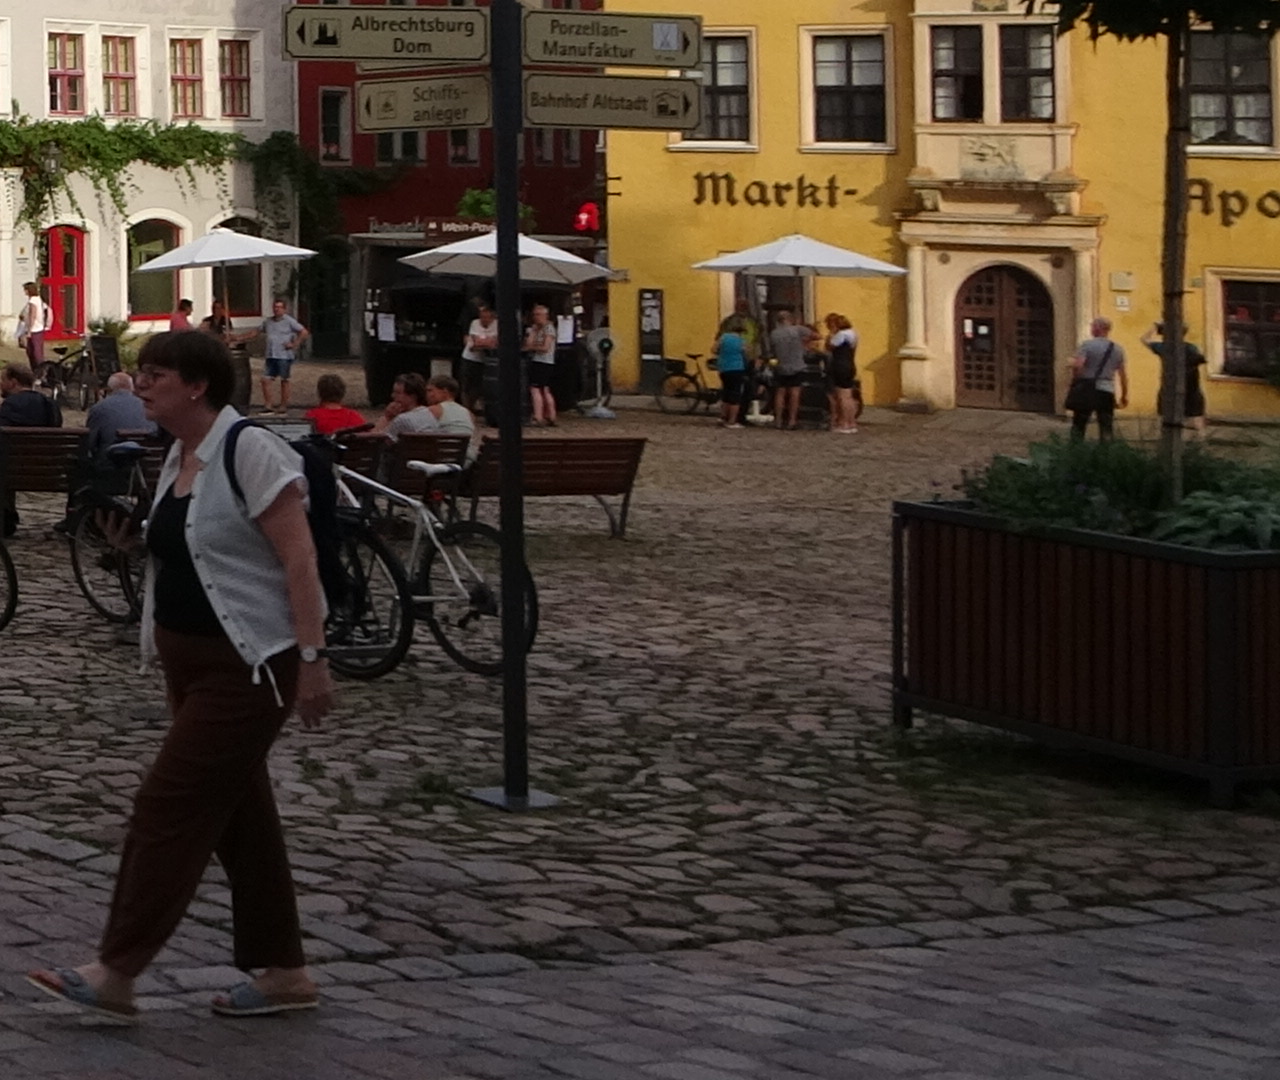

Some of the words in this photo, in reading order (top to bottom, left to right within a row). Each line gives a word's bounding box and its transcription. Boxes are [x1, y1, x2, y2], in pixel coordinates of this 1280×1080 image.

[351, 16, 475, 37] Albrechtsburg
[549, 20, 629, 37] Porzellan-
[393, 38, 432, 53] Dom
[542, 40, 637, 58] Manufaktur
[412, 85, 469, 102] Schiffs-
[530, 91, 589, 110] Bahnhof
[592, 94, 649, 112] Altstadt
[413, 107, 469, 124] anleger
[693, 172, 858, 208] Markt-
